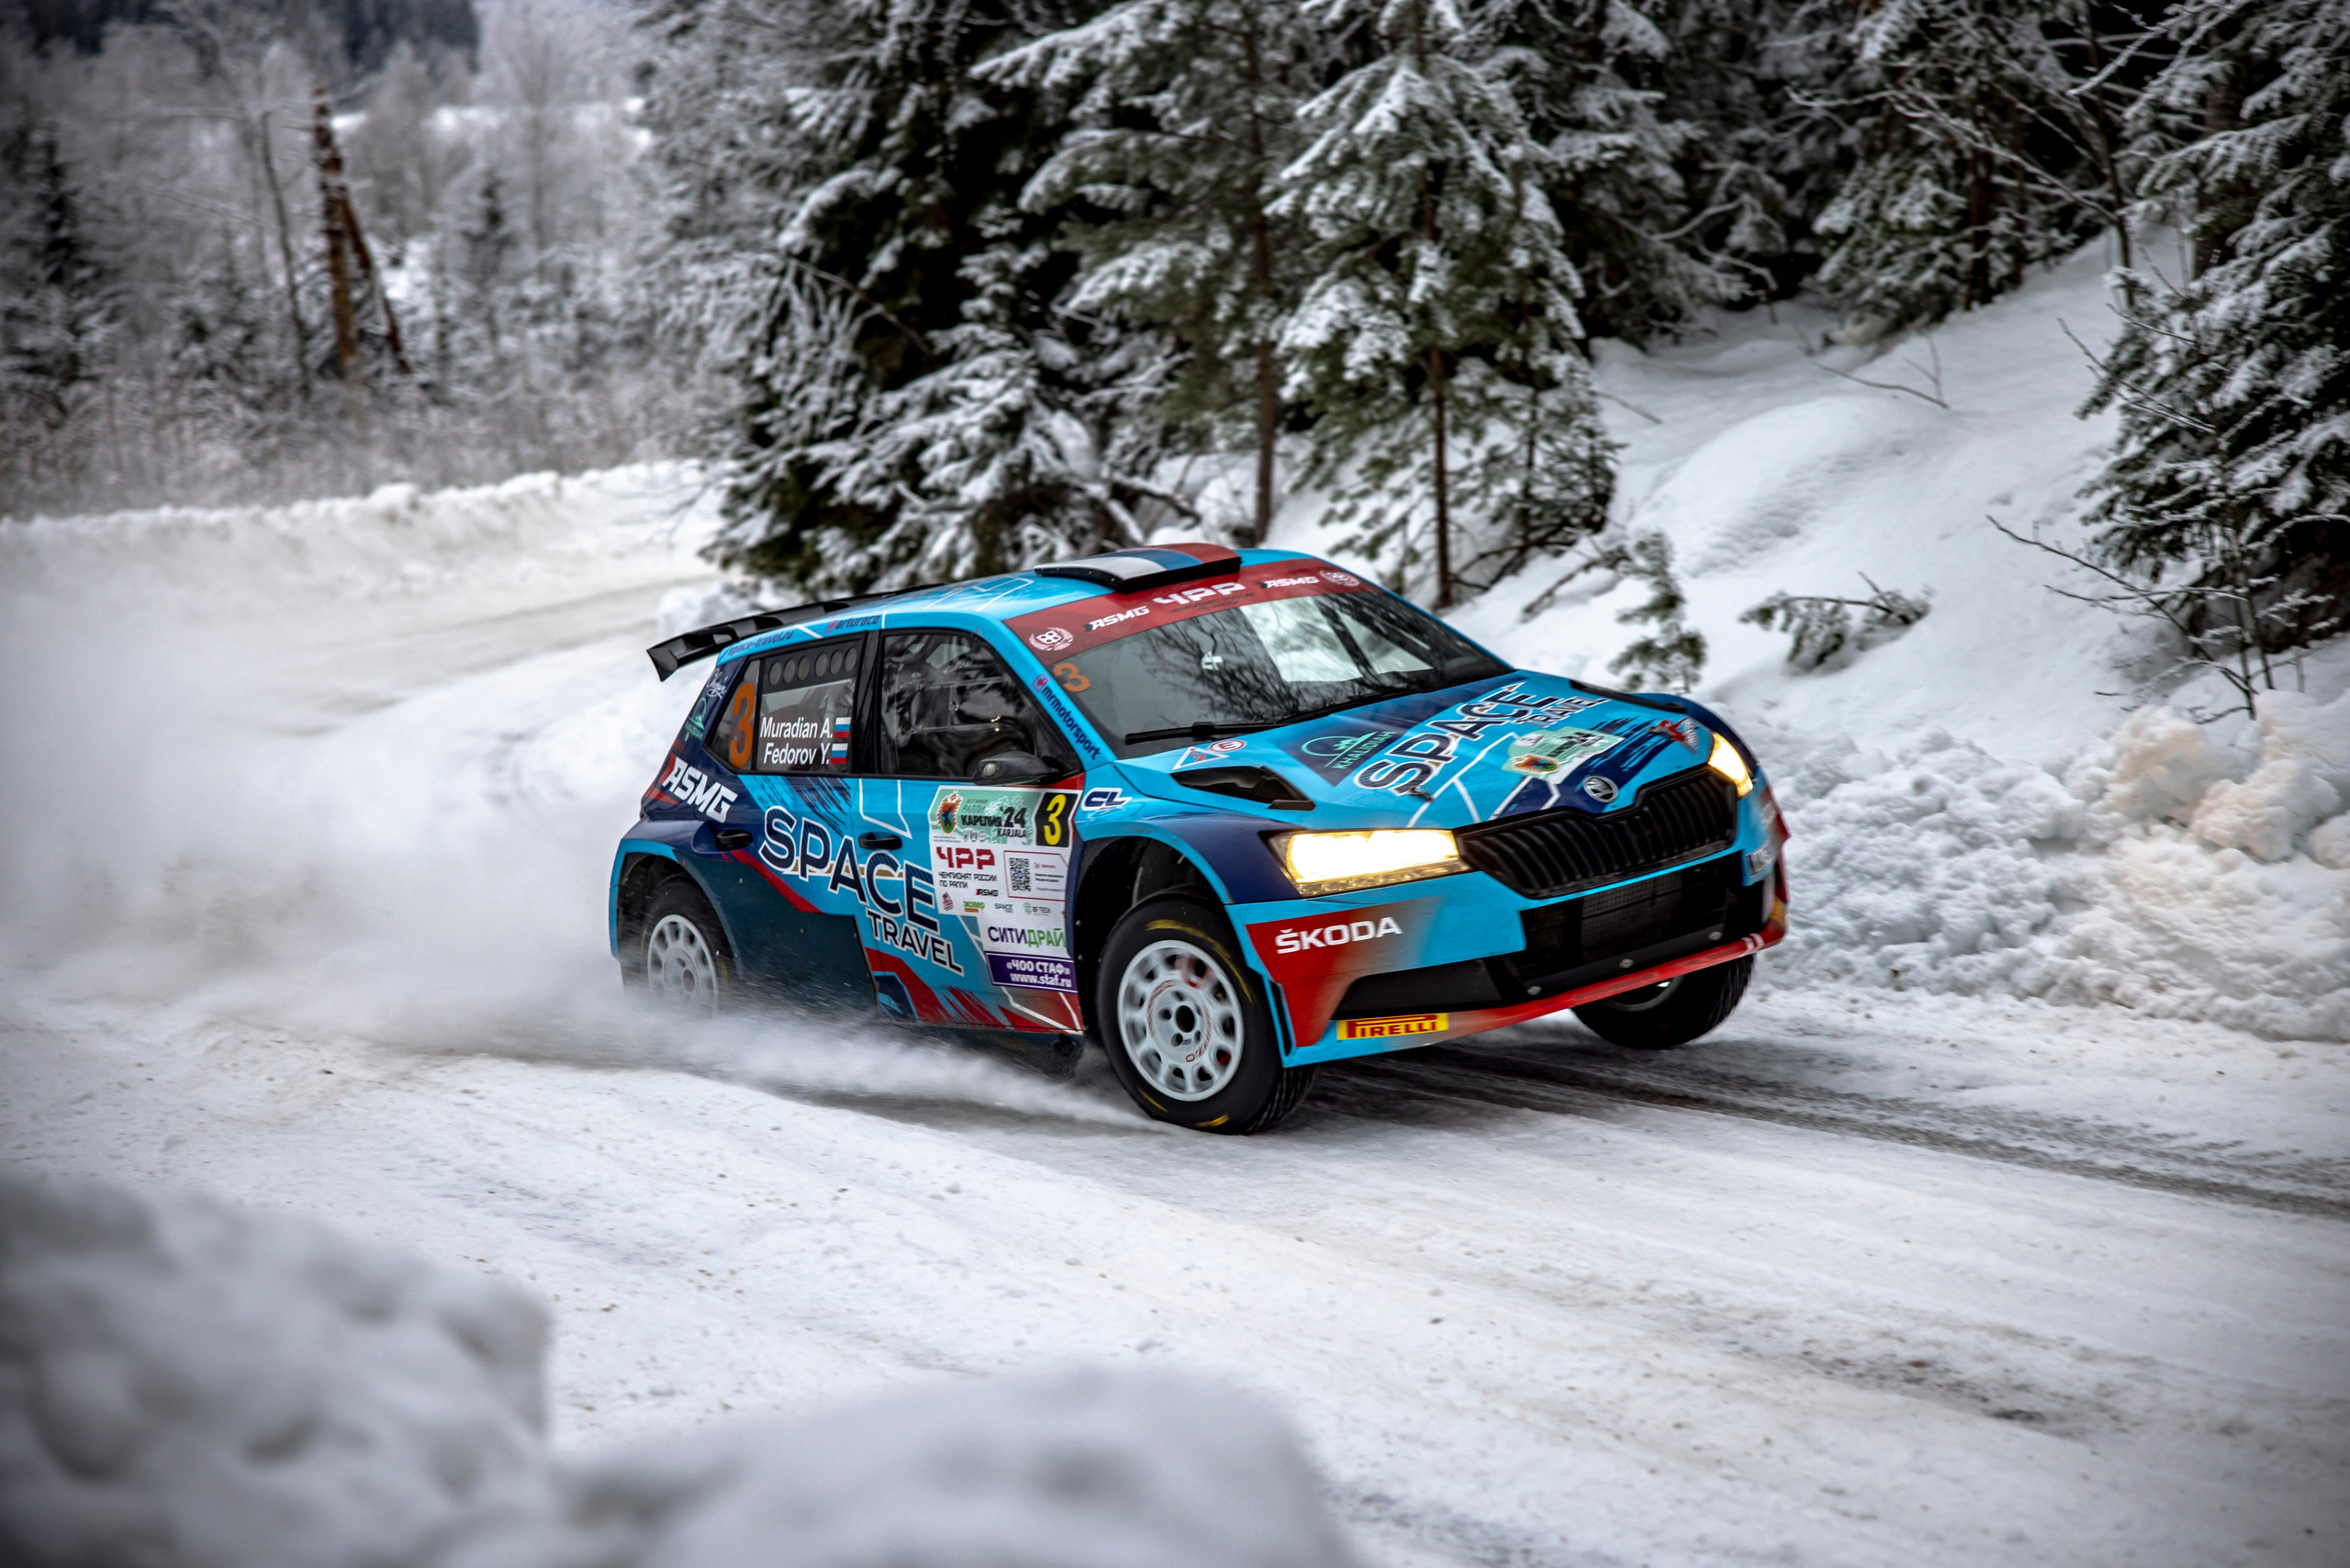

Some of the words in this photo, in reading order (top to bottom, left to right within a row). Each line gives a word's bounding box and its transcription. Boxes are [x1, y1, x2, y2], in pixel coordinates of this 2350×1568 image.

[1262, 576, 1319, 588] ASMG
[834, 614, 880, 630] arturace
[1086, 605, 1150, 632] ASMG
[727, 630, 794, 656] space-travel.ru
[1053, 663, 1091, 692] 3
[729, 682, 755, 768] 3
[760, 716, 819, 738] Muradian
[819, 717, 834, 738] A.
[1042, 686, 1101, 760] mrmotorsport
[763, 742, 817, 765] Fedorov
[820, 742, 832, 765] Y.
[1218, 740, 1236, 750] E
[1352, 689, 1560, 797] SPACE
[661, 756, 738, 823] ASMG
[1083, 790, 1128, 809] CL
[960, 814, 1002, 827] КАРЕЛИЯ
[1044, 794, 1068, 846] 3
[997, 827, 1027, 838] KARJALA
[758, 805, 941, 935] SPACE
[937, 871, 973, 880] ЧЕМПИОНАТ
[973, 873, 998, 882] РОССИИ
[948, 880, 969, 889] РАЛЛИ
[976, 888, 999, 897] ASMG
[866, 907, 965, 977] TRAVEL
[1274, 916, 1404, 955] ŠKODA
[1010, 972, 1072, 988] www.staf.ru
[1346, 1014, 1438, 1038] PIRELLI
